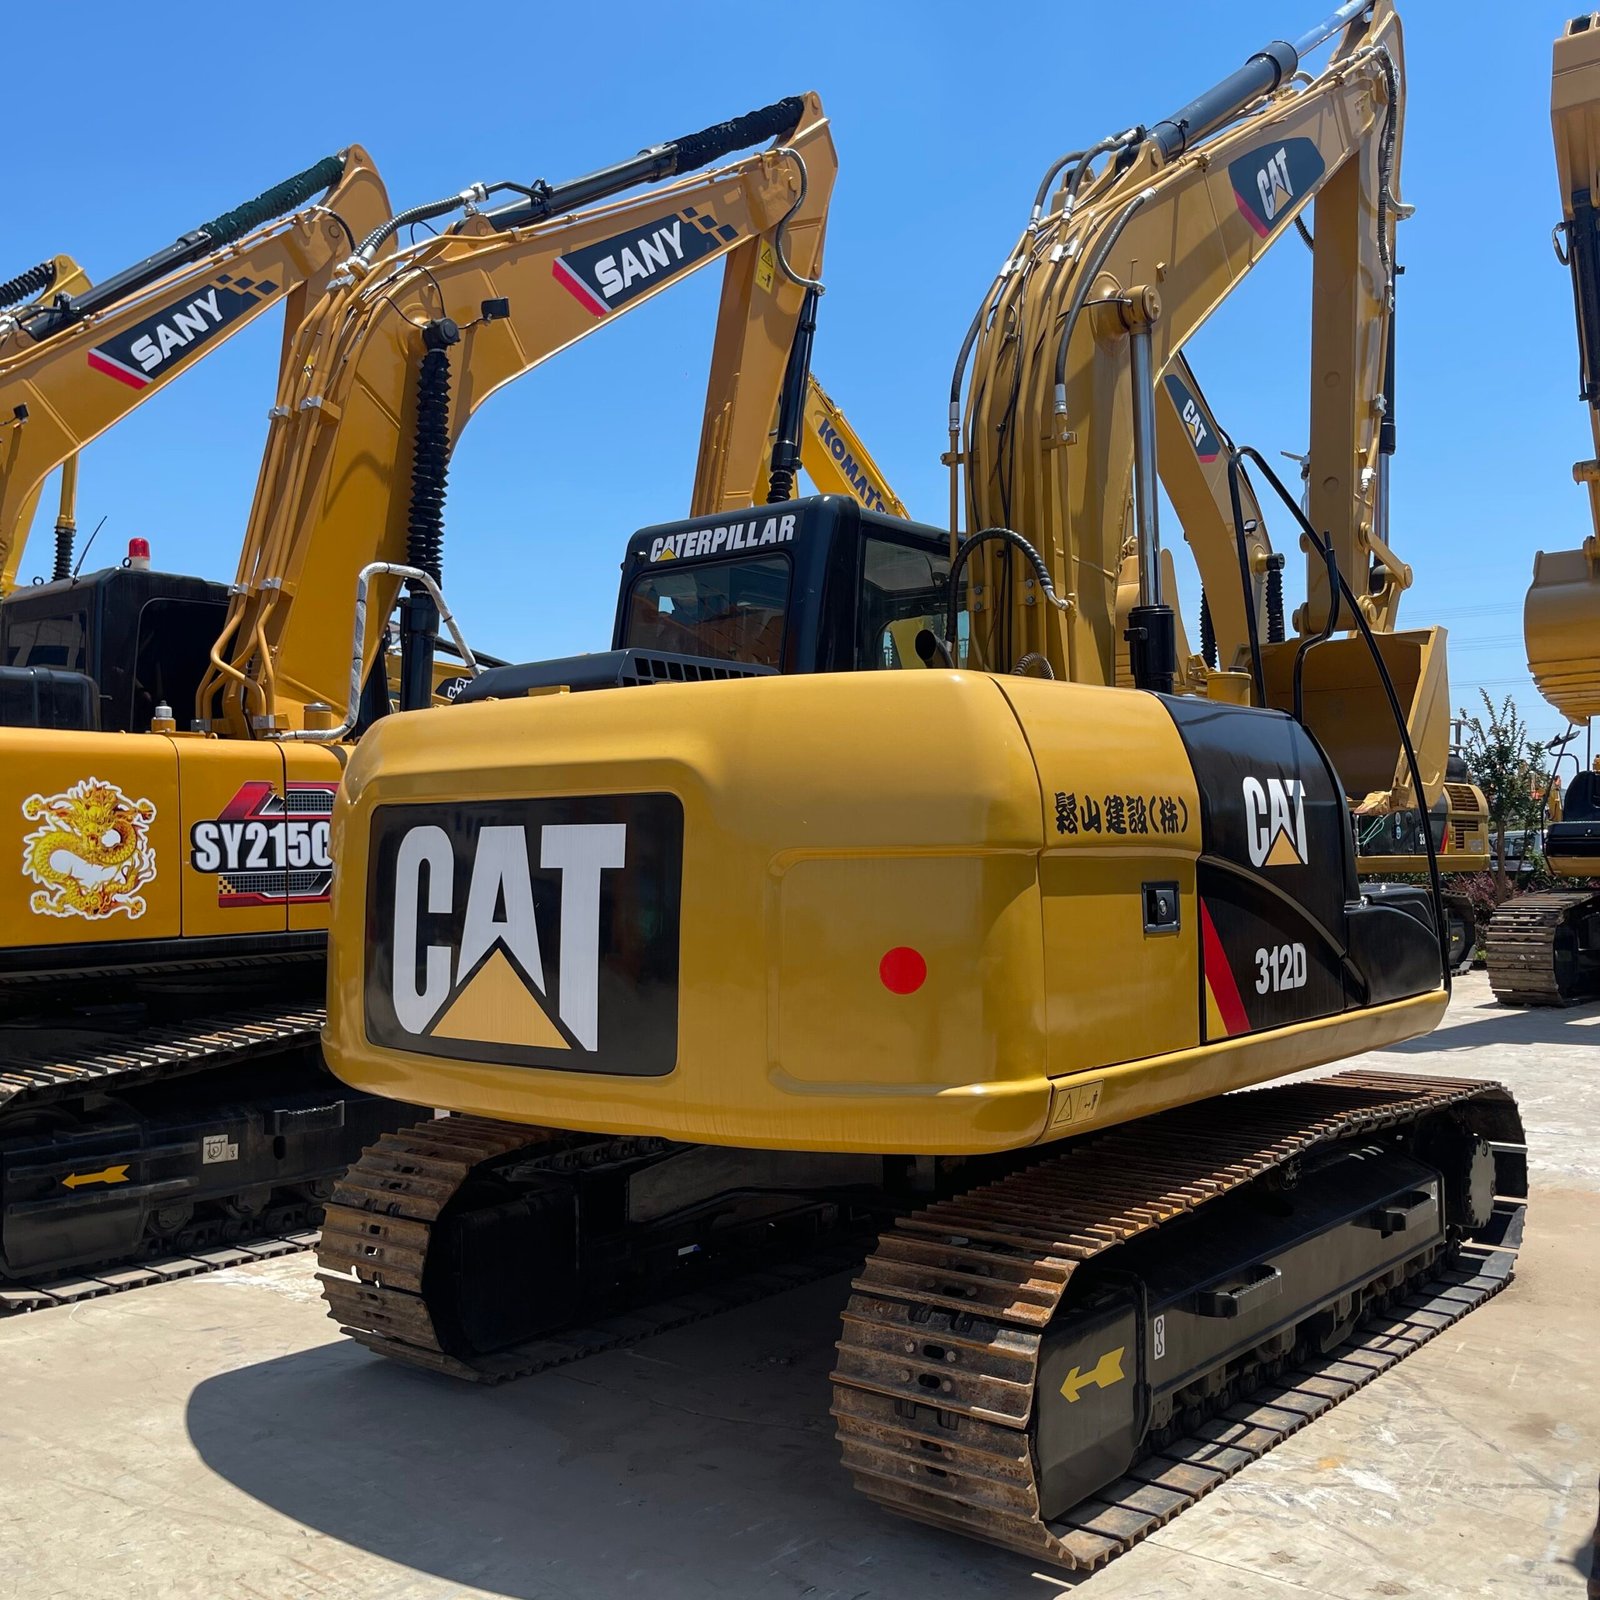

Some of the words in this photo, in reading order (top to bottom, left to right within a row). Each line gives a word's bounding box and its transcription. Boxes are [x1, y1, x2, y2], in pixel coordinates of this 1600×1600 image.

[1256, 147, 1294, 220] CAT
[594, 220, 684, 299] SANY
[130, 288, 223, 373] SANY
[1182, 399, 1207, 447] CAT
[817, 418, 889, 515] KOMATS
[649, 514, 797, 563] CATERPILLAR
[1242, 776, 1309, 868] CAT
[392, 823, 627, 1052] CAT
[1255, 942, 1307, 995] 312D
